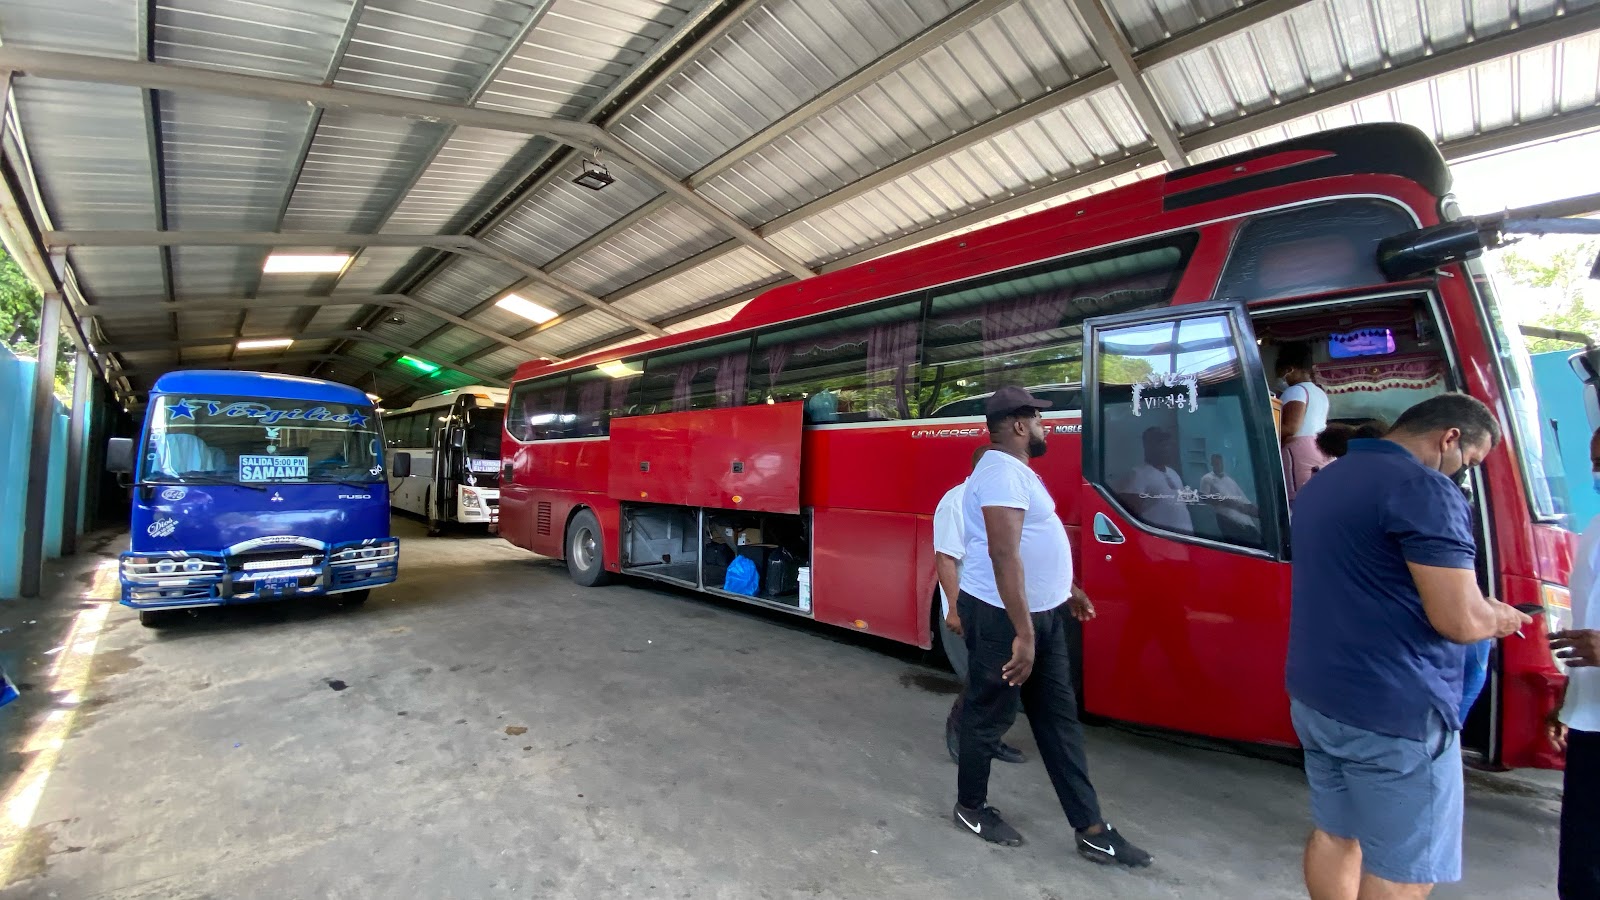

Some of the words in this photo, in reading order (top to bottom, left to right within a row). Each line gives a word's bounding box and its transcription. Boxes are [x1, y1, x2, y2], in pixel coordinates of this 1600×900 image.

[205, 400, 357, 424] Virgilio
[911, 428, 980, 439] UNIVERSE
[242, 457, 273, 466] SALIDA
[242, 466, 305, 480] SAMANA
